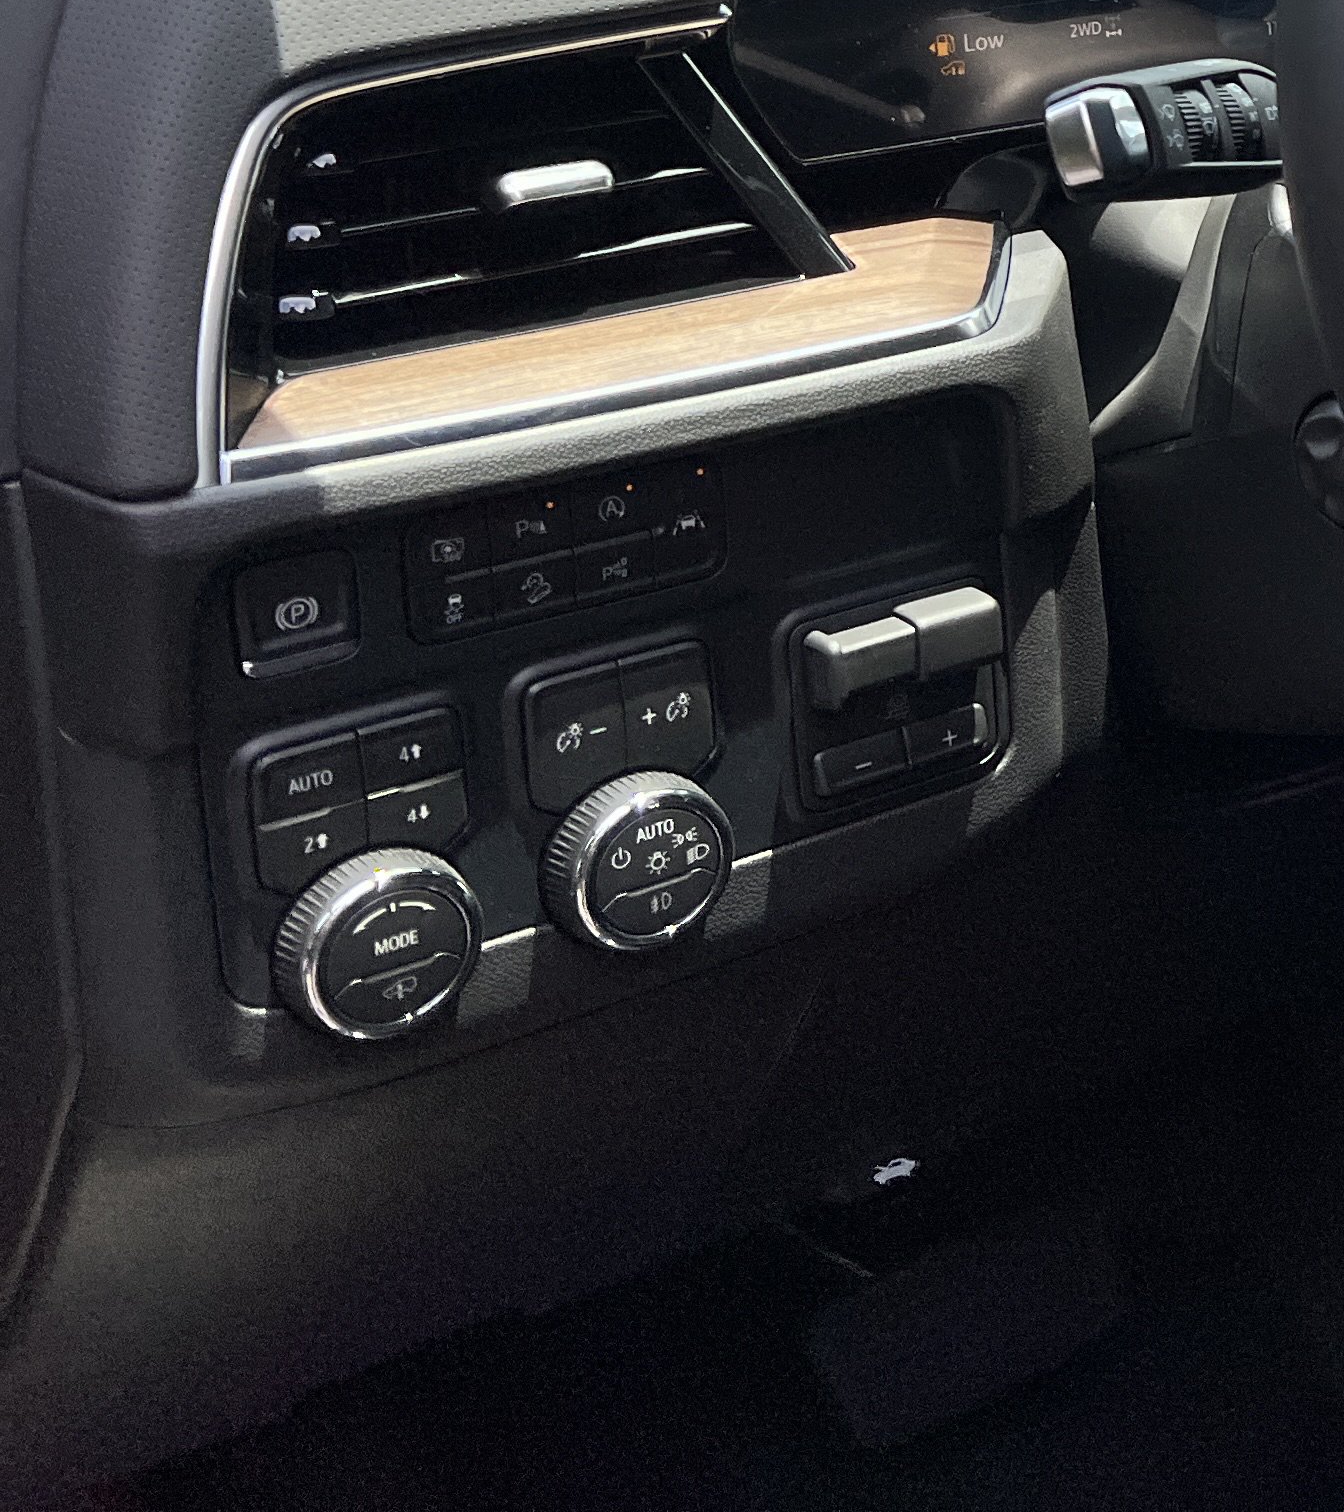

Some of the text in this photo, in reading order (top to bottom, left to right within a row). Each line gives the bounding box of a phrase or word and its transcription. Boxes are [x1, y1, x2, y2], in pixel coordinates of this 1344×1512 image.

[963, 33, 1004, 52] Low
[1069, 21, 1102, 38] 2WD
[288, 769, 334, 795] AUTO
[636, 818, 674, 844] AUTO
[374, 929, 420, 957] MODE
